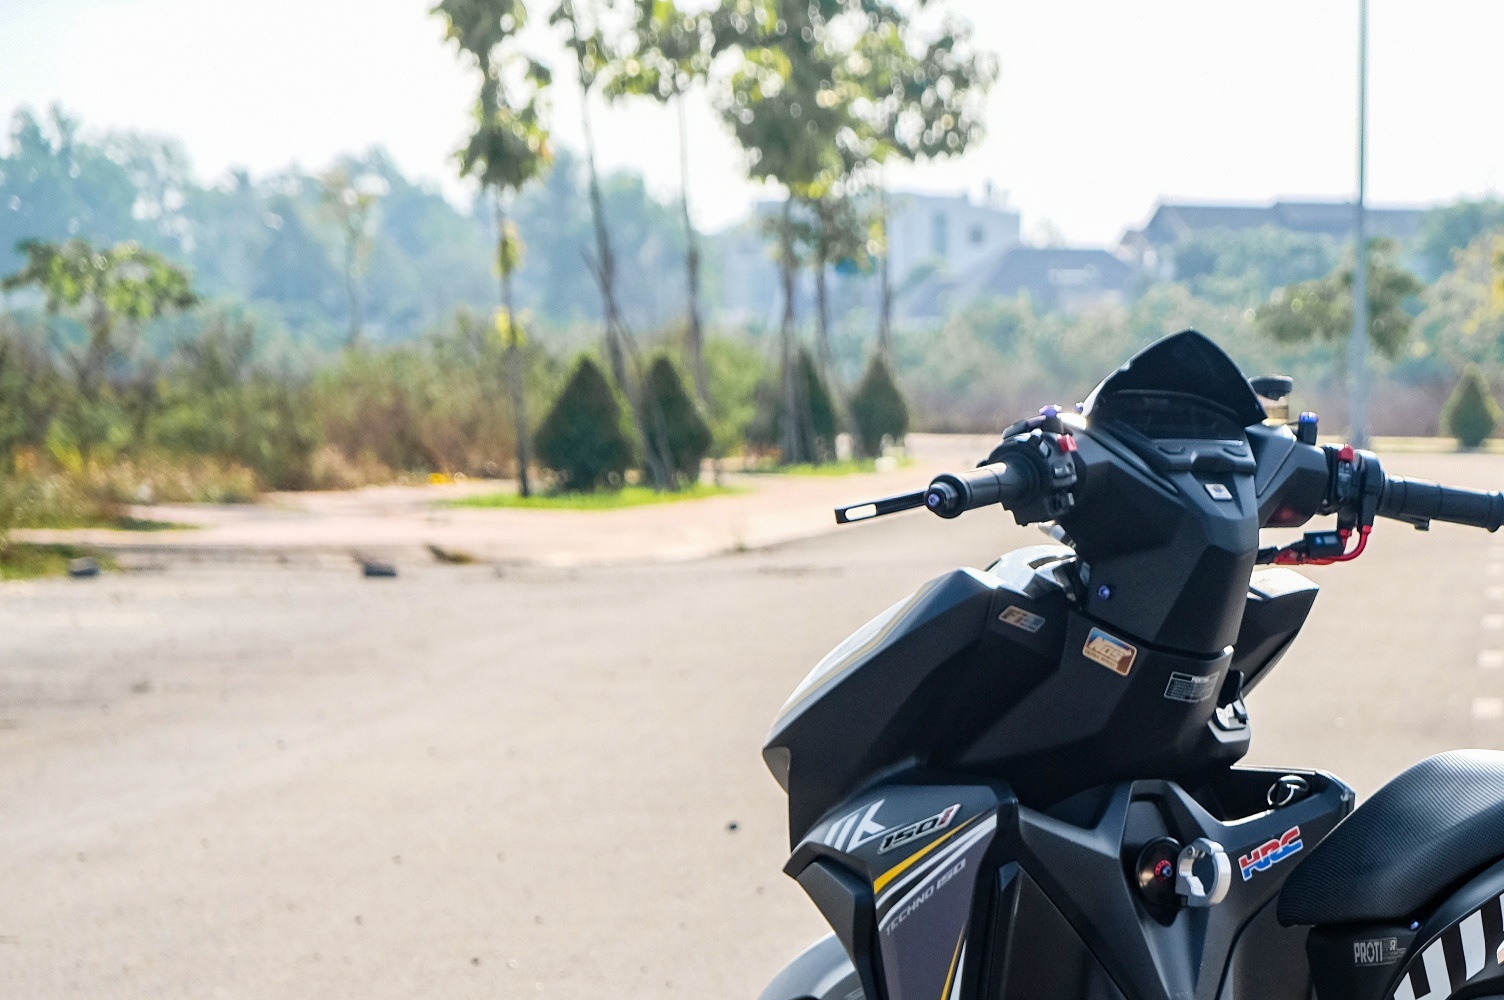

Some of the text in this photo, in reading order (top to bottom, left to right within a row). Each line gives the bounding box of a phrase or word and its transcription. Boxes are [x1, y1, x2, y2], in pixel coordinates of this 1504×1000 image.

[1238, 825, 1304, 881] HRC
[886, 858, 966, 936] TECHNO 150
[1354, 941, 1383, 963] PROTI
